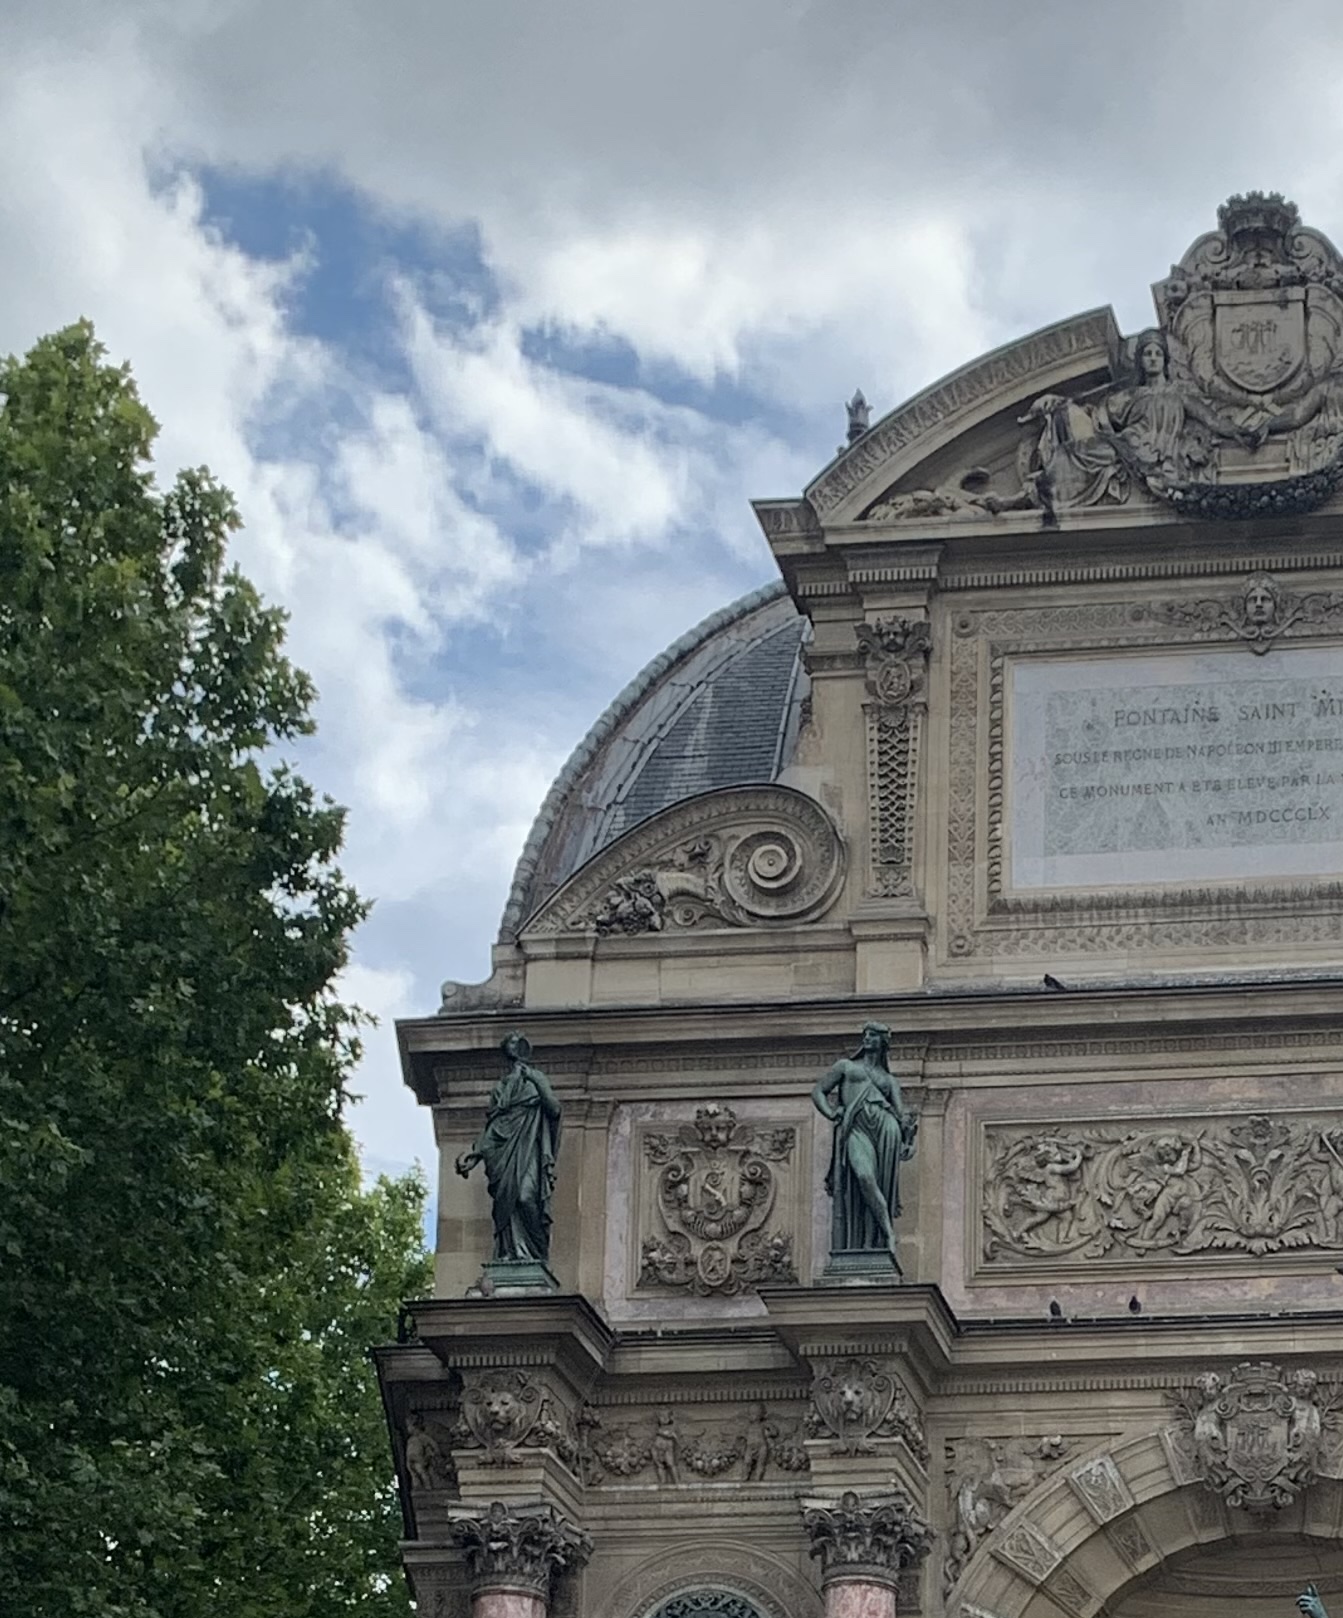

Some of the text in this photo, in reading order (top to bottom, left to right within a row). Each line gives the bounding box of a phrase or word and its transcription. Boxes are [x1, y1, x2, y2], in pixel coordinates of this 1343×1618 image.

[1113, 706, 1221, 728] FONTAINE
[1238, 702, 1298, 722] SAINT
[1054, 751, 1091, 766] SOUS
[1165, 747, 1184, 760] DE
[1059, 787, 1078, 800] CE
[1083, 781, 1175, 799] MONUMENT
[1281, 773, 1311, 788] PAR
[1316, 772, 1335, 785] LA
[1237, 804, 1331, 825] MDCCCLX
